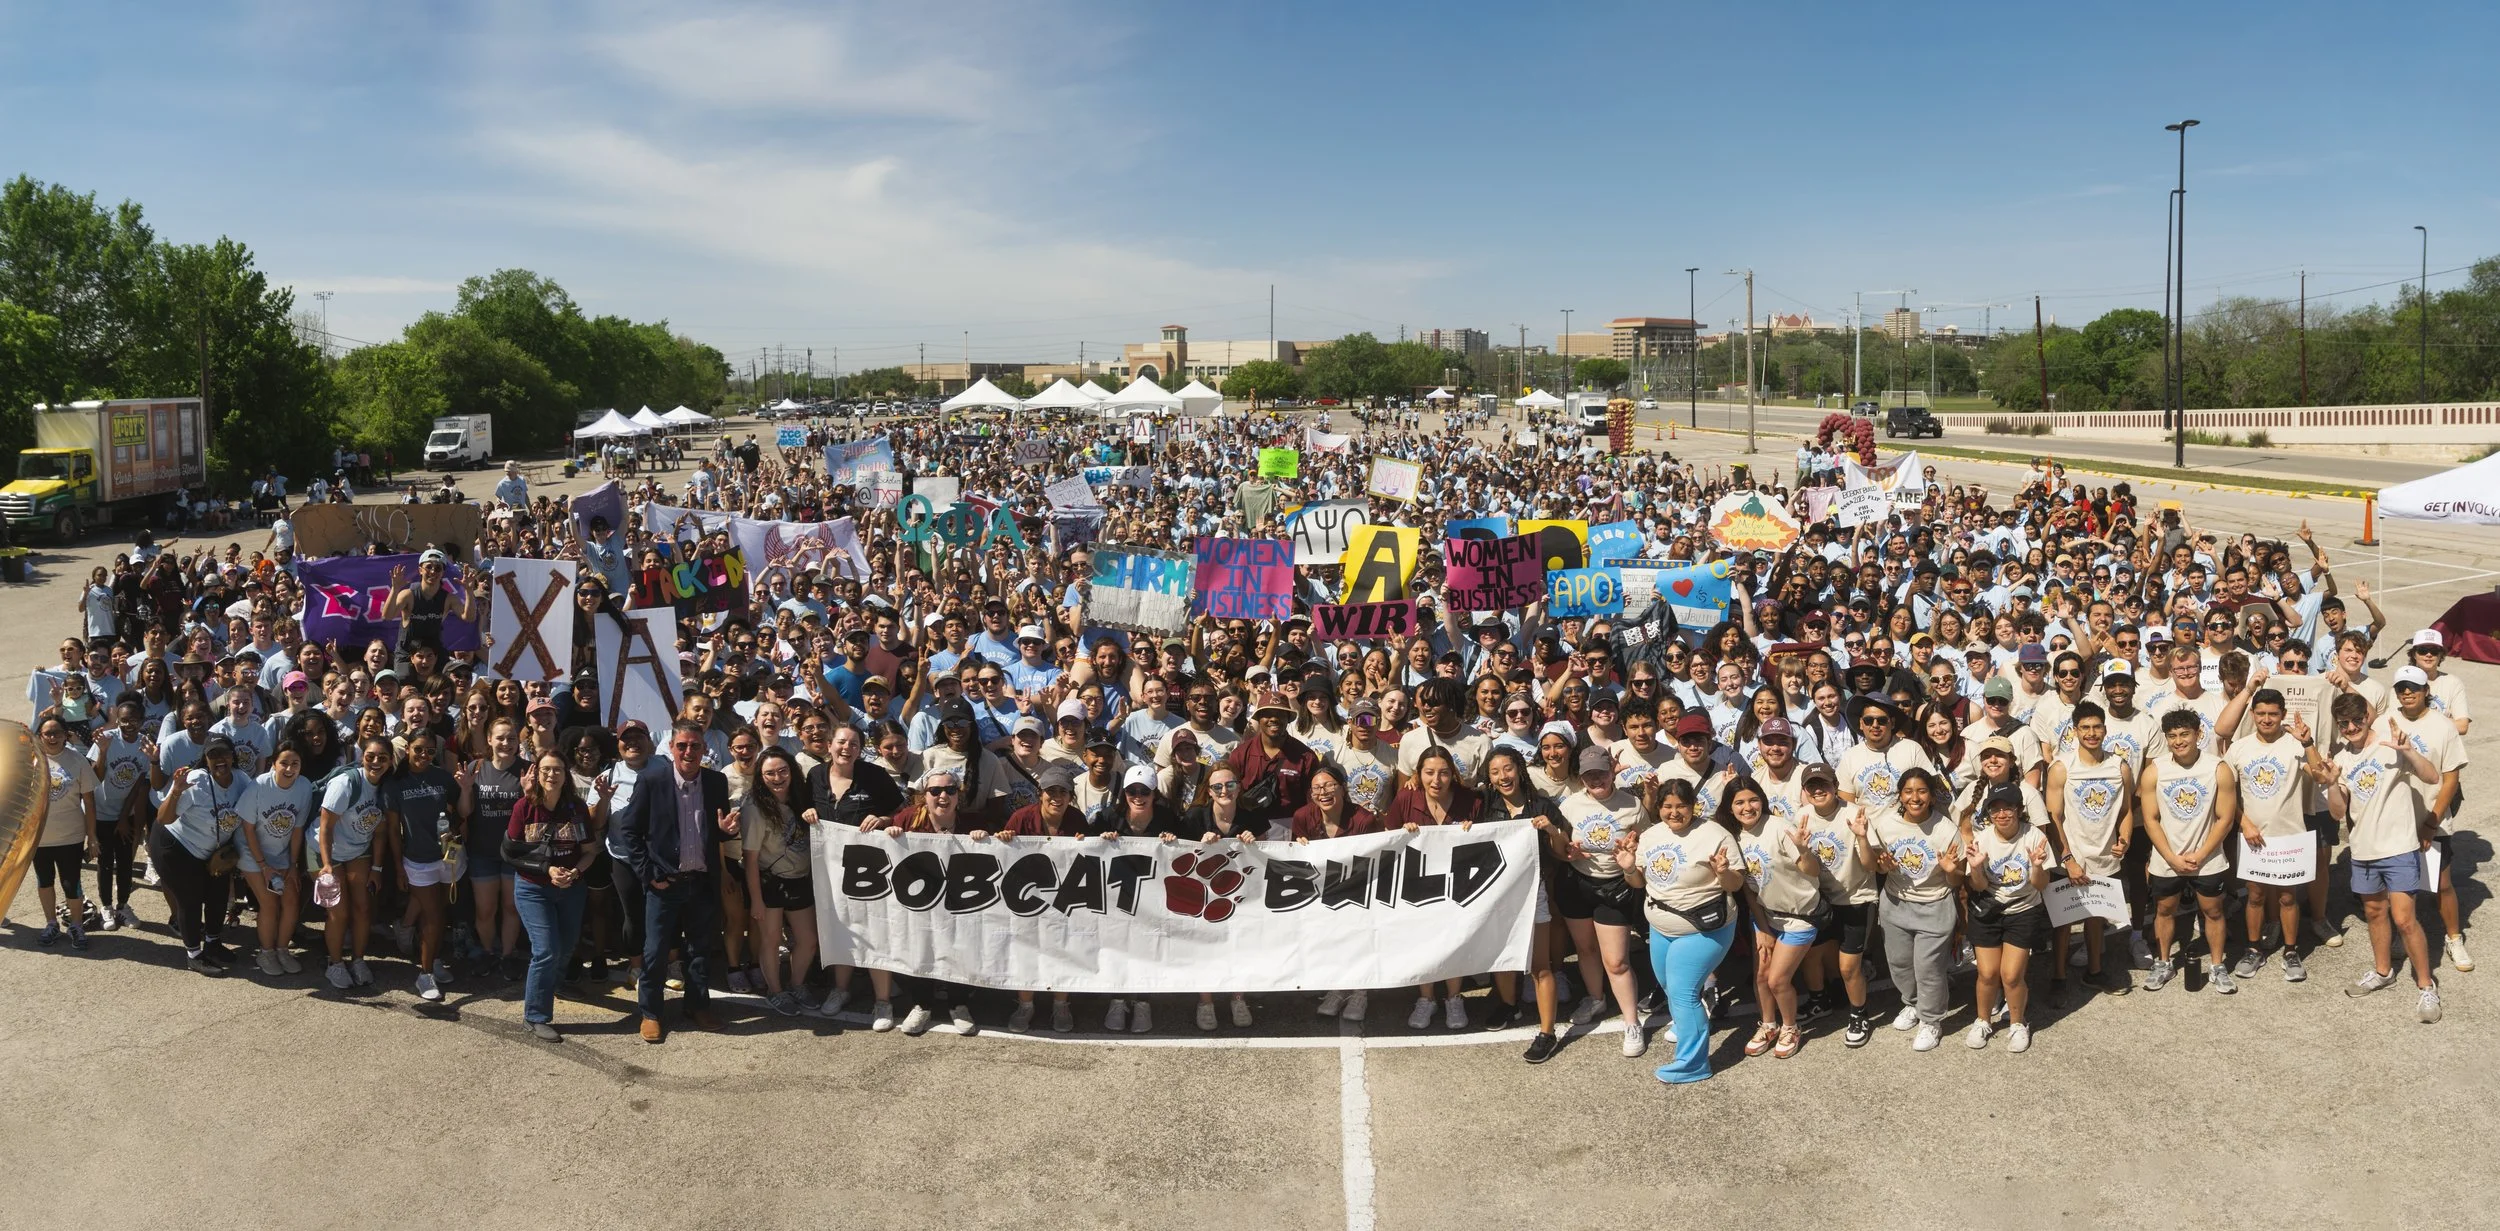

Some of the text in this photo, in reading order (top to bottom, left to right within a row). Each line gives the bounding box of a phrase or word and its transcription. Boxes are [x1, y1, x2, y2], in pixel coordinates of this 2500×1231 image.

[473, 420, 487, 432] Hertz
[842, 442, 878, 457] Alpha
[858, 486, 902, 506] @ TXST
[1841, 487, 1862, 499] BOBCAT
[1862, 485, 1878, 494] BUILD
[1853, 508, 1875, 517] KAPPA
[2424, 502, 2450, 512] GET
[1737, 518, 1765, 530] McCoy
[1194, 539, 1296, 568] WOMEN
[1446, 532, 1537, 568] WOMEN
[1091, 551, 1190, 598] SHRM
[1223, 564, 1263, 593] IN
[1477, 559, 1520, 590] IN
[1449, 581, 1538, 612] BUSINESS
[1554, 572, 1614, 608] APO
[1190, 589, 1292, 621] BUSINESS
[1318, 602, 1409, 636] WIB
[2286, 687, 2305, 696] FIJI
[1620, 764, 1648, 782] Bobcat
[2243, 755, 2288, 776] Bobcat Build
[480, 784, 500, 792] DON'T
[2074, 777, 2099, 797] Bobcat
[2163, 777, 2209, 797] Bobcat Build
[1700, 787, 1717, 810] Build
[261, 801, 286, 819] Bobcat
[482, 809, 512, 817] COUNTING
[1577, 812, 1622, 832] Bobcat Build
[1827, 831, 1846, 852] Build
[1888, 836, 1937, 862] Bobcat Build
[2279, 847, 2304, 856] Jobsites
[1645, 842, 1688, 865] Bobcat Build
[1753, 844, 1772, 864] Build
[841, 840, 1508, 917] BOBCAT BUILD
[2249, 870, 2306, 880] BOBCAT BUILD
[2063, 901, 2090, 912] Jobsites
